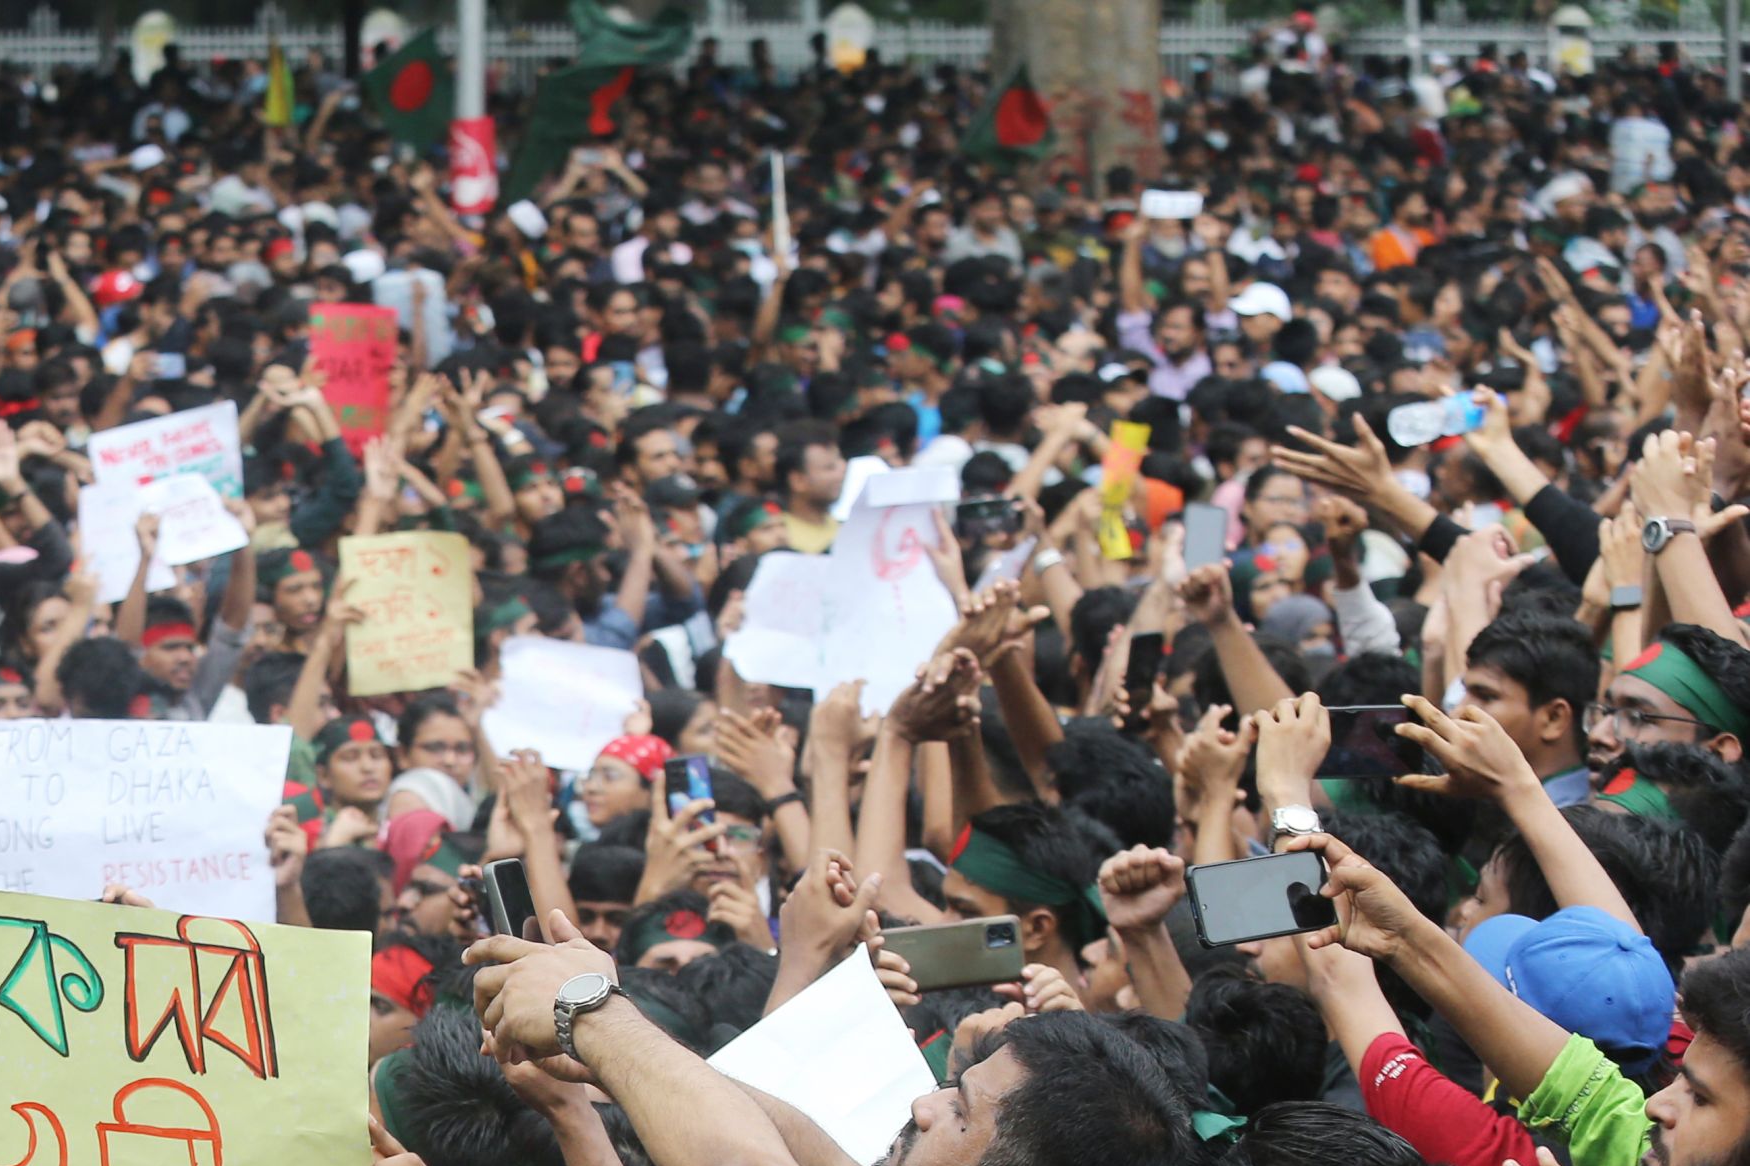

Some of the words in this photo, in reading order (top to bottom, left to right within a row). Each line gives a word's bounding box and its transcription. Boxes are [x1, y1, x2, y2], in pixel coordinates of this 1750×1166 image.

[108, 725, 195, 762] GAZA
[22, 773, 65, 806] TO
[107, 769, 215, 803] DHAKA
[103, 812, 166, 846] LIVE
[103, 852, 253, 889] RESISTANCE
